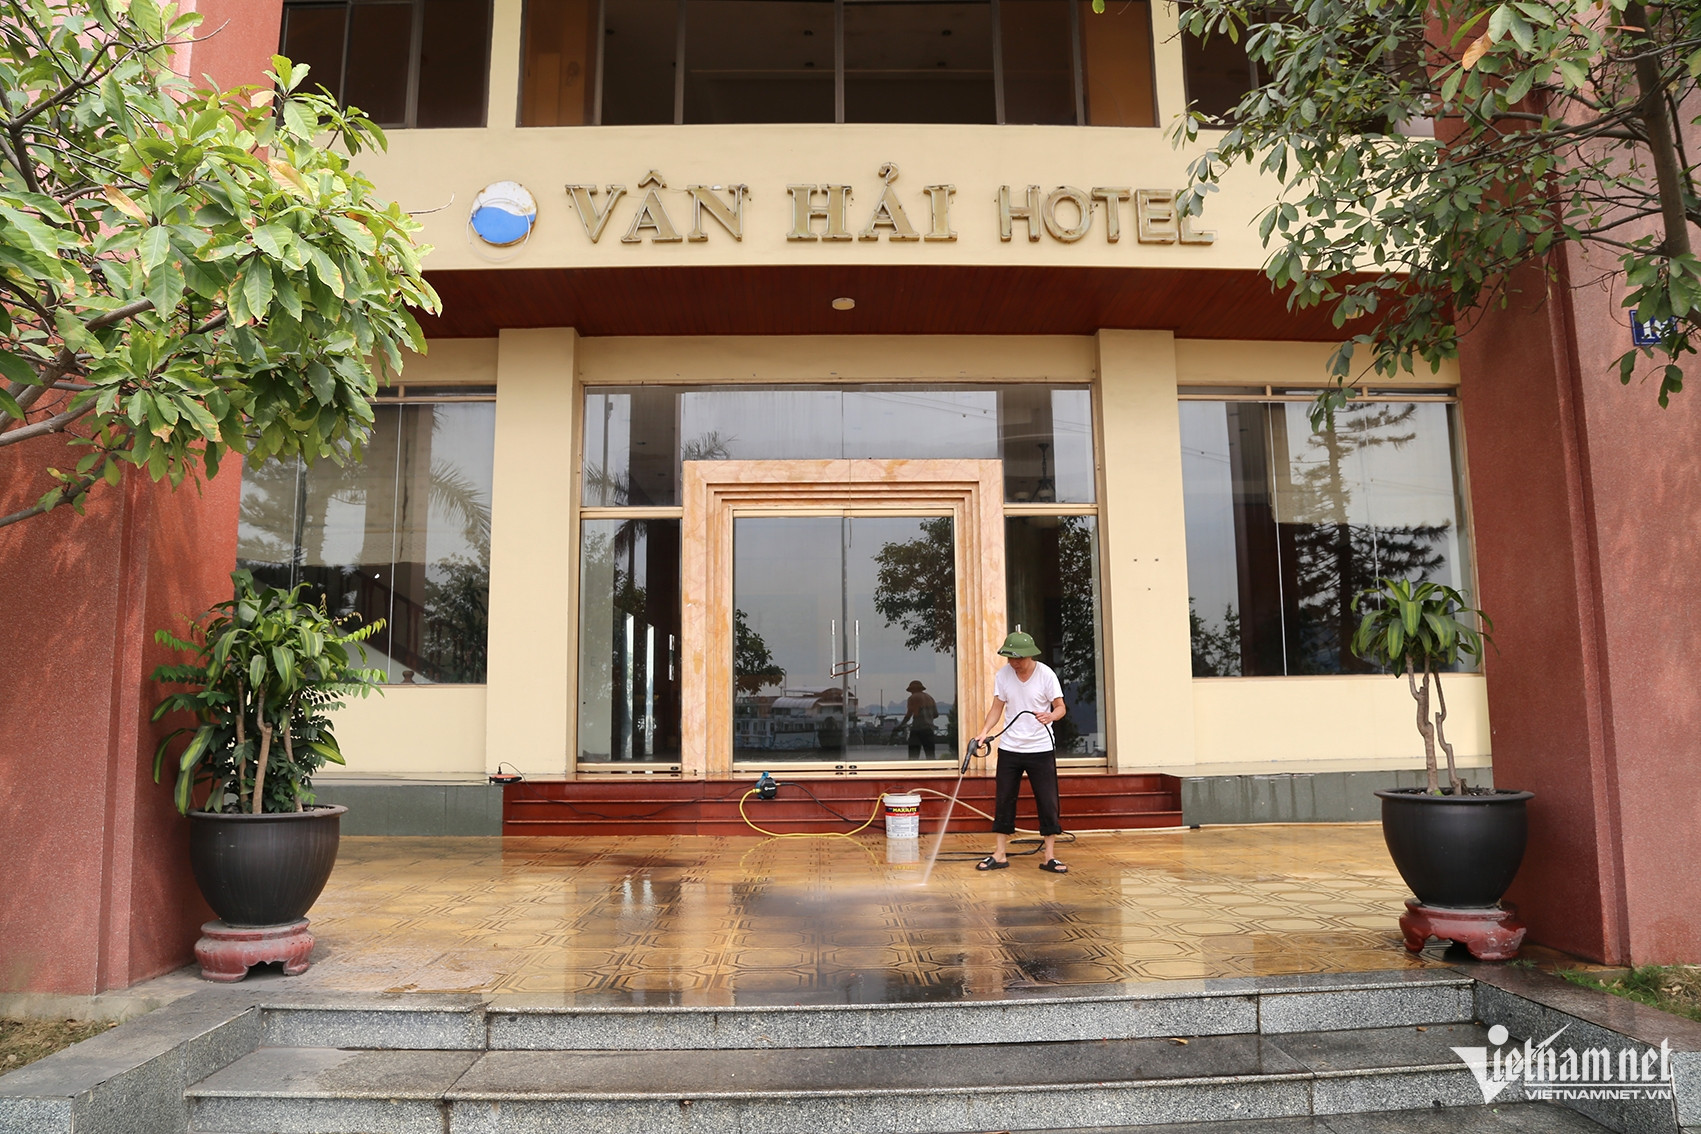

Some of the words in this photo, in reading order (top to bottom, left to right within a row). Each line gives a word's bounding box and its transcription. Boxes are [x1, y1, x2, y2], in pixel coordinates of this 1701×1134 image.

[566, 169, 749, 243] VÂN
[786, 161, 957, 243] HẢI
[998, 184, 1216, 245] HOTEL
